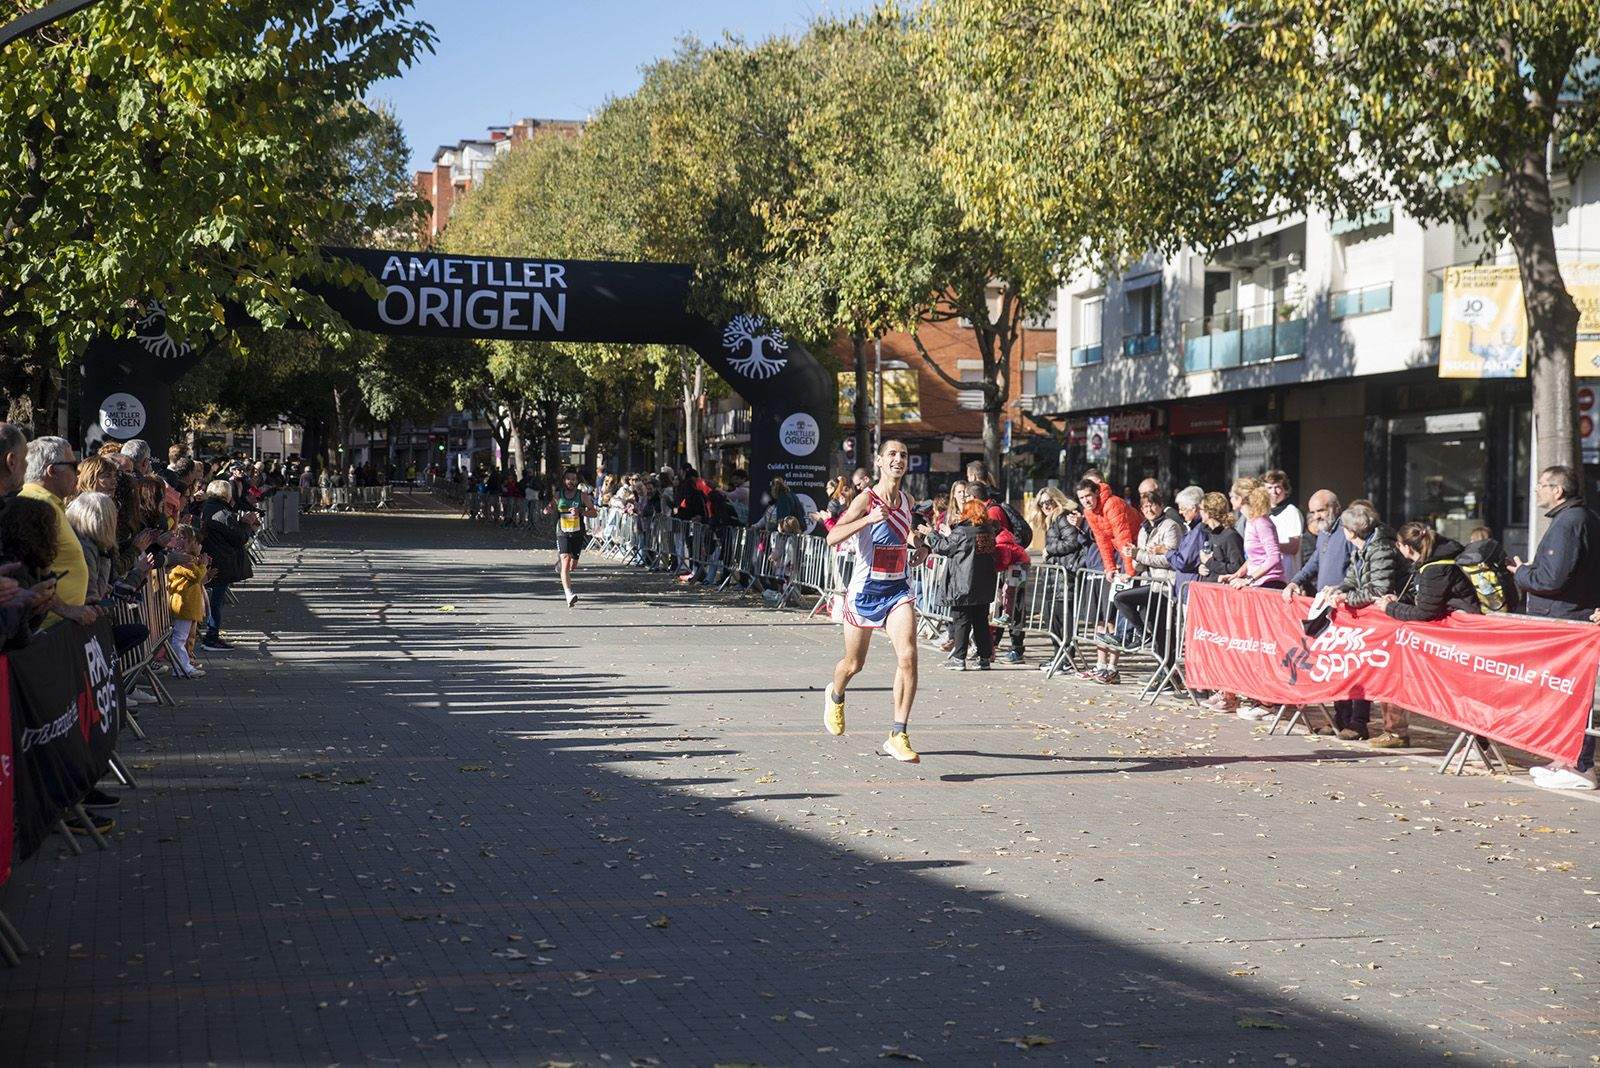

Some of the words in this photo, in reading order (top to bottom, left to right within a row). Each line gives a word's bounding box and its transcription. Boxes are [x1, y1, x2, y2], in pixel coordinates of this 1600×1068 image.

[380, 255, 568, 289] AMETLLER
[377, 284, 567, 332] ORIGEN
[1464, 299, 1483, 313] JO
[105, 411, 140, 419] AMETLLER
[104, 418, 141, 428] ORIGEN
[784, 436, 816, 446] ORIGEN
[1395, 627, 1419, 650] We
[1423, 639, 1470, 666] make
[1473, 655, 1537, 685] people
[1541, 668, 1576, 695] feel
